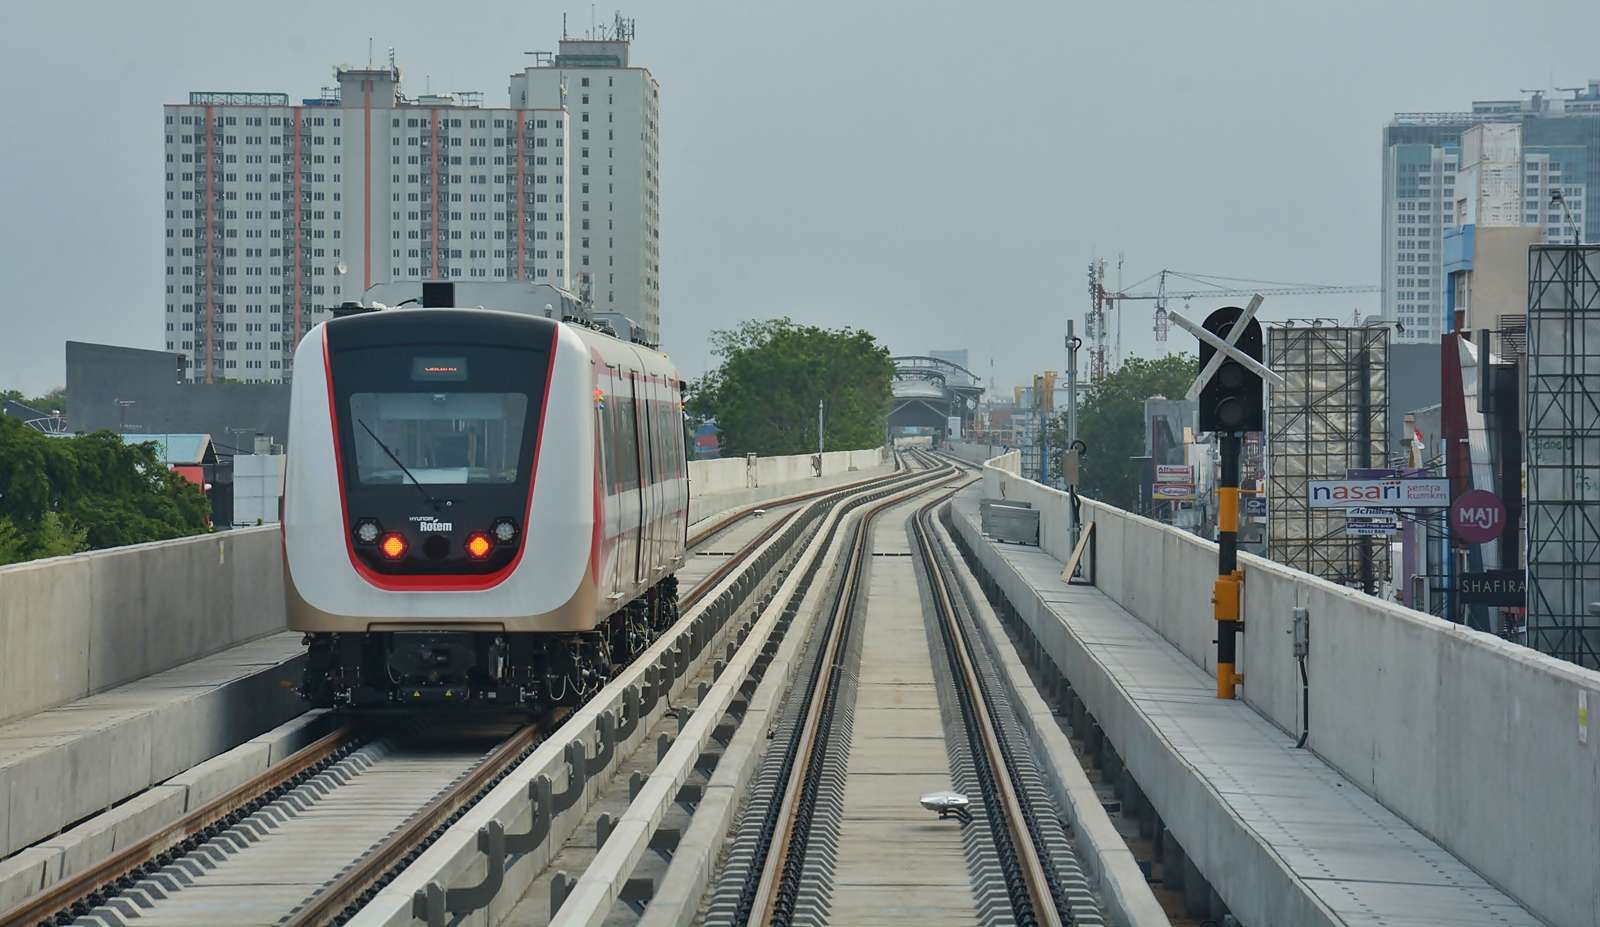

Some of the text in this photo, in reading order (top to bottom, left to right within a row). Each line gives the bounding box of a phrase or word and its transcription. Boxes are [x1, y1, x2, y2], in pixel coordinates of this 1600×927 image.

[1313, 481, 1401, 500] nasari
[420, 519, 452, 532] Rotem
[1460, 508, 1499, 529] MAJI
[1463, 580, 1526, 593] SHAFIRA
